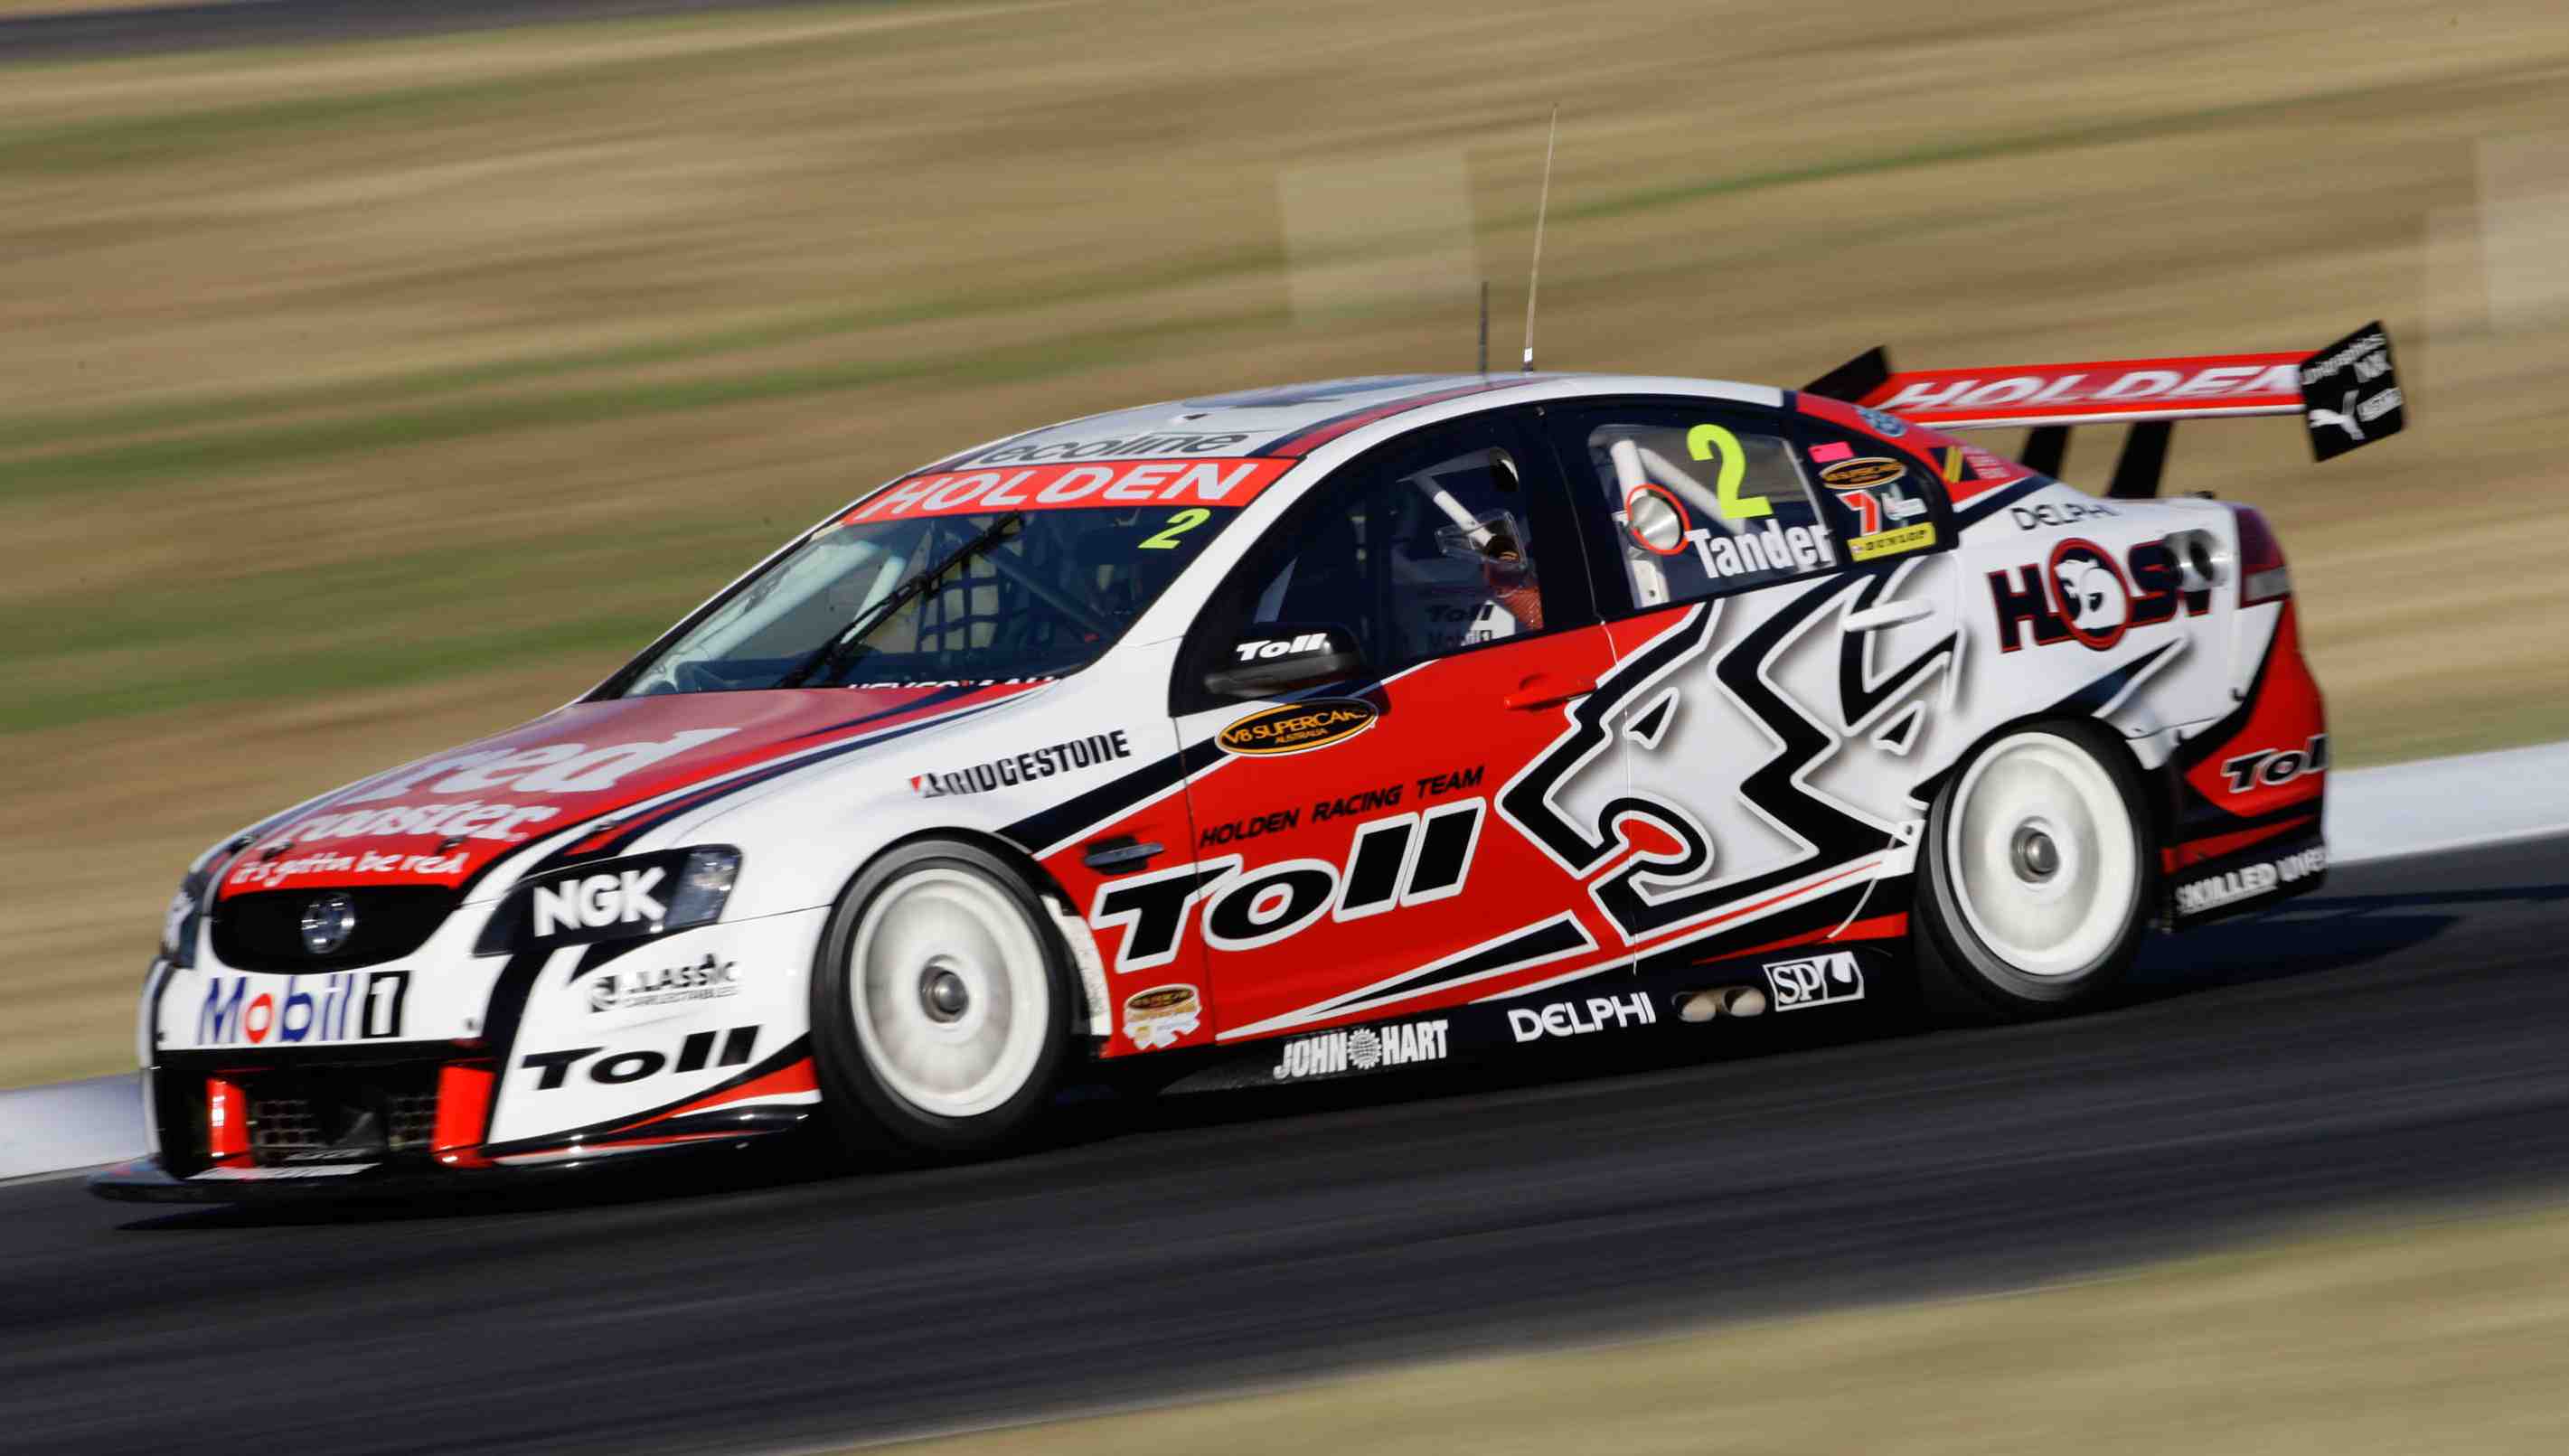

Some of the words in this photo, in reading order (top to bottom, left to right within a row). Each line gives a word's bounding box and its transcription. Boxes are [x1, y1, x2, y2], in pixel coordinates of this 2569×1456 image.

[978, 433, 1247, 464] ecoline
[1687, 424, 1773, 519] 2
[854, 463, 1259, 521] HOLDEN
[1137, 508, 1212, 550] 2
[1685, 518, 1833, 578] Tander
[1236, 633, 1328, 662] Toll
[342, 728, 740, 806] red
[922, 729, 1132, 799] BRIDGESTONE
[1222, 727, 1254, 746] V8
[1200, 808, 1301, 848] HOLDEN
[1311, 784, 1404, 823] RACING
[1416, 766, 1485, 798] TEAM
[354, 848, 404, 873] be
[400, 851, 470, 874] red
[1091, 796, 1487, 974] Toll
[533, 866, 667, 938] NGK
[196, 973, 357, 1046] Mobil
[366, 973, 406, 1038] 1
[1508, 991, 1657, 1044] DELPHI
[519, 1024, 762, 1092] Toll
[1273, 1032, 1348, 1081] JOHN
[1381, 1019, 1449, 1066] HART
